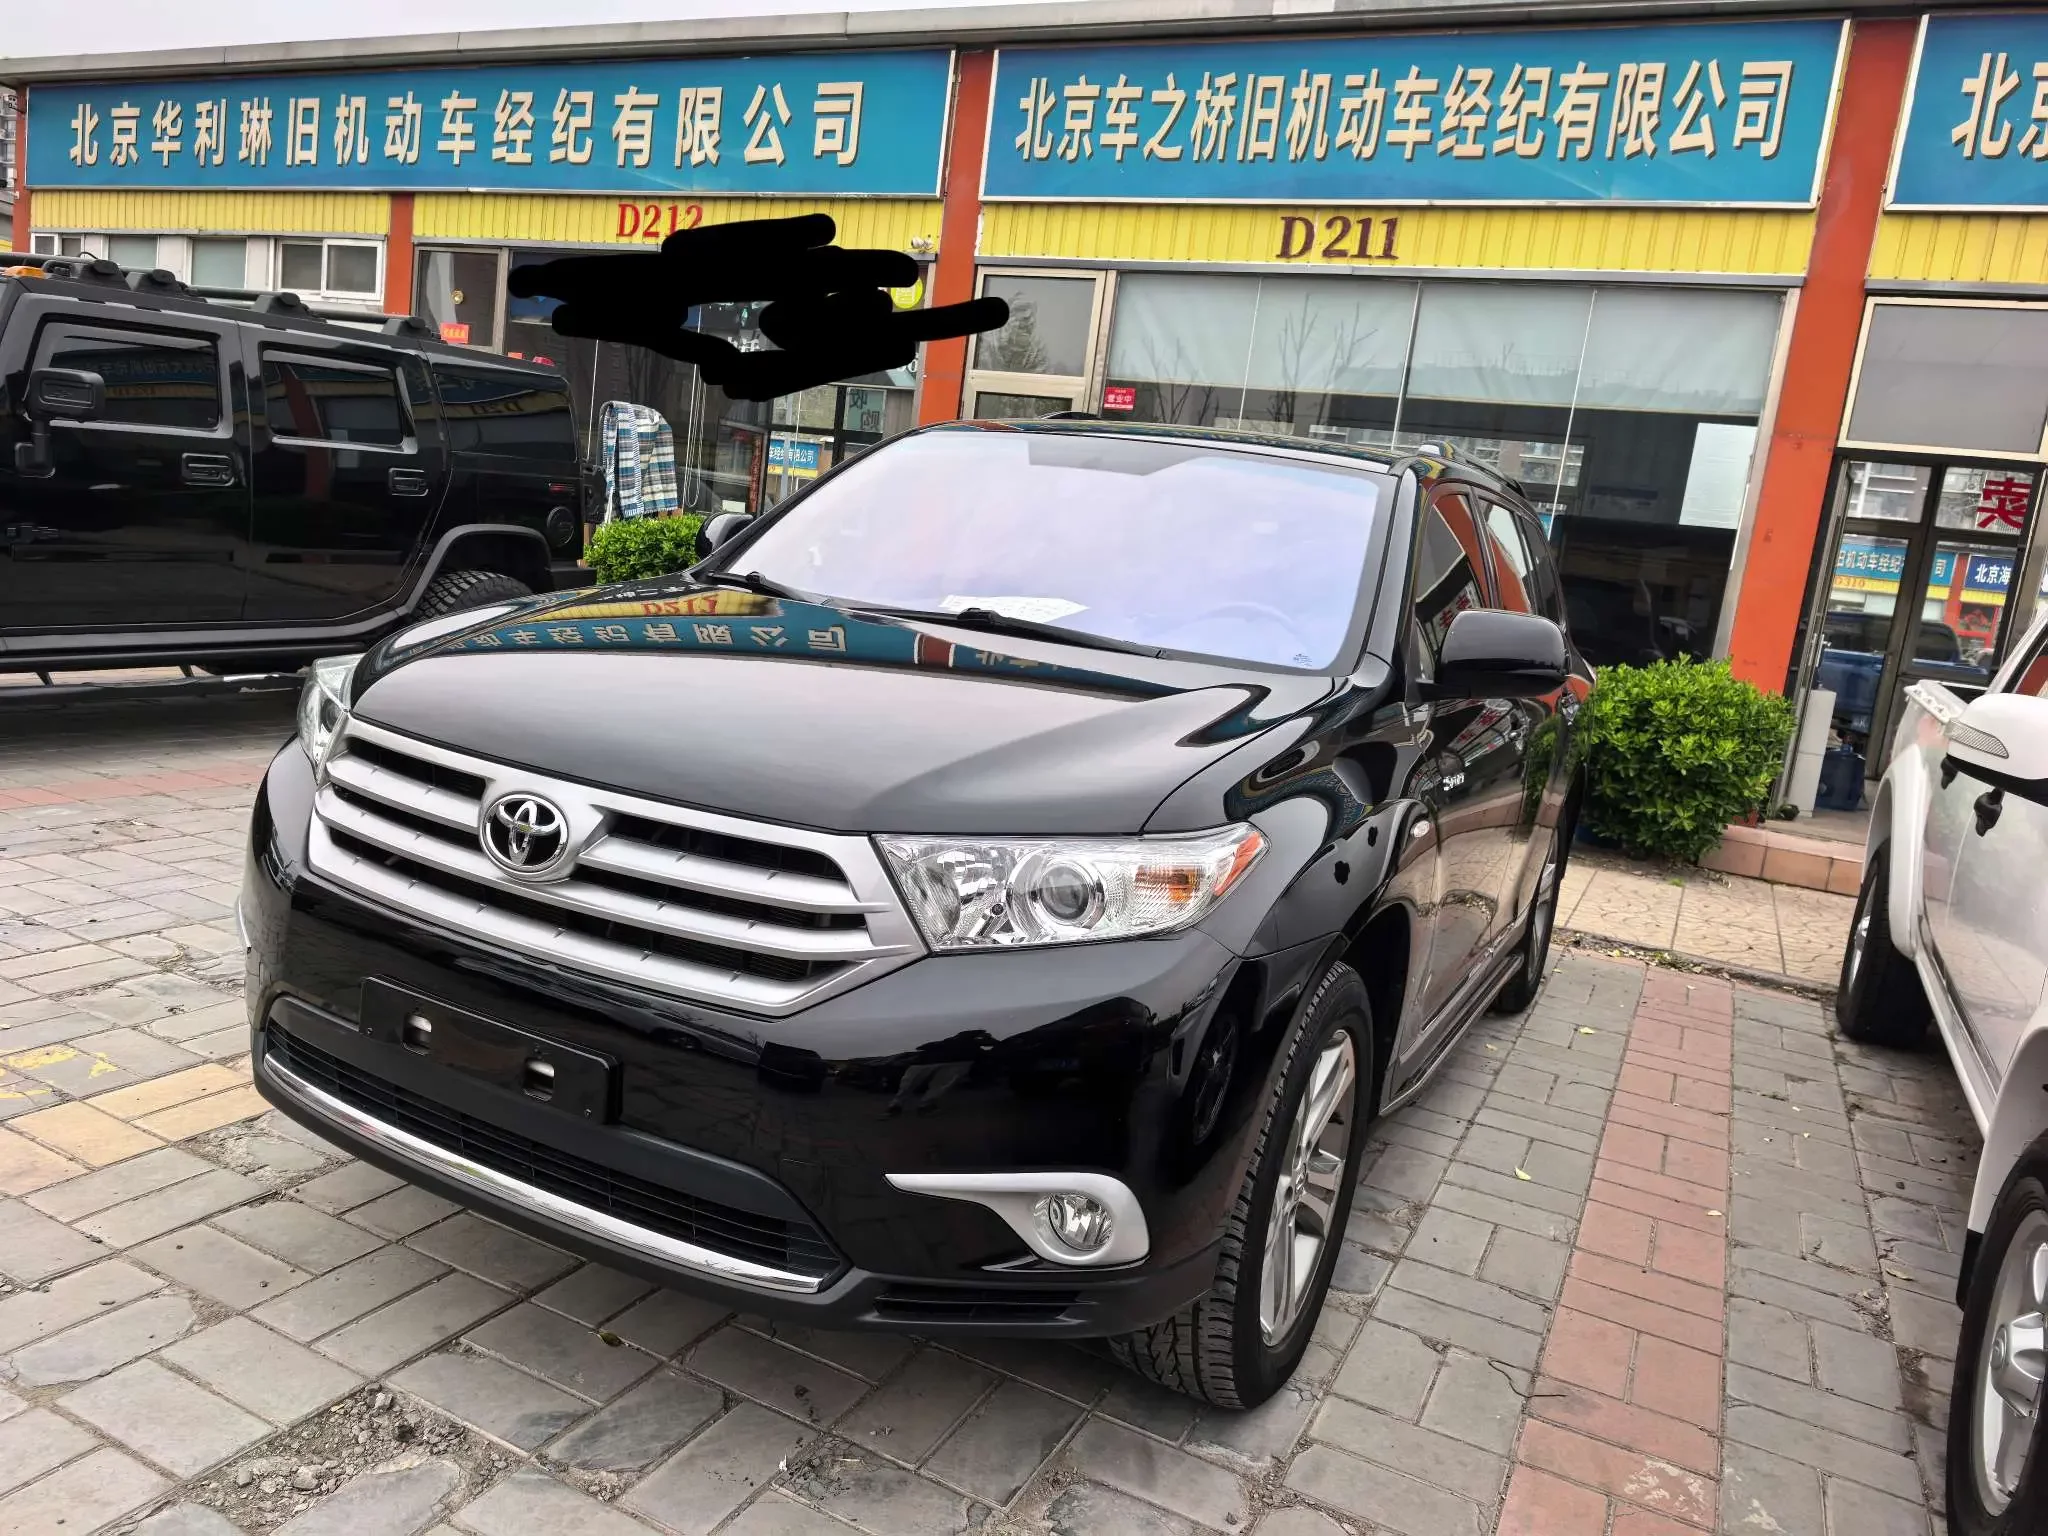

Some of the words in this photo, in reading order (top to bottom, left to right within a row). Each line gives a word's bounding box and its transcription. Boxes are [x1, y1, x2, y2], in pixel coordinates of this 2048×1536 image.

[69, 82, 864, 168] 北京华利琳旧机动车经纪有限公司
[1015, 60, 1794, 162] 北京车之桥旧机动车经纪有限公司
[616, 203, 703, 238] D212
[1275, 215, 1399, 260] D211
